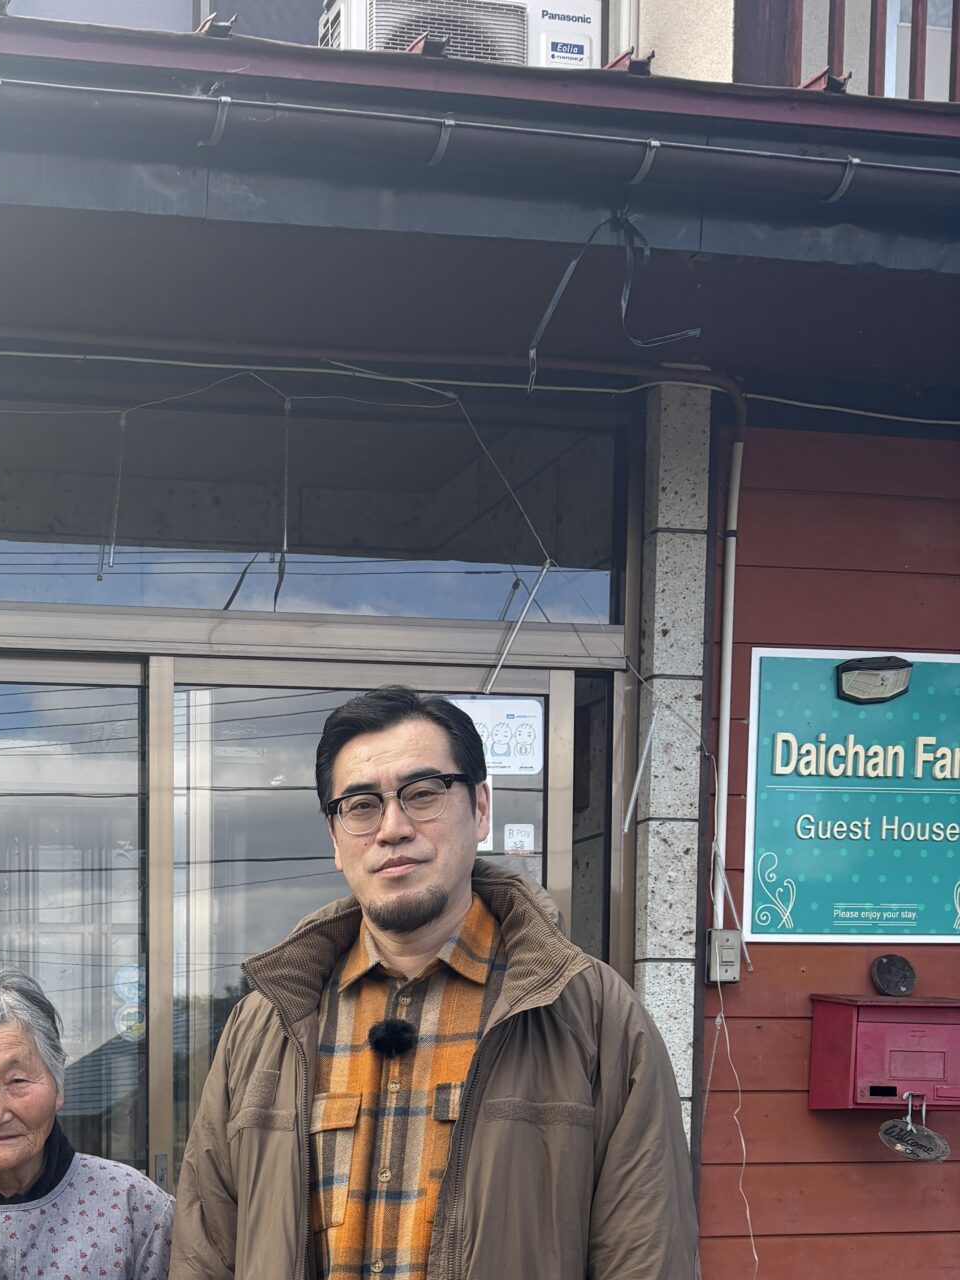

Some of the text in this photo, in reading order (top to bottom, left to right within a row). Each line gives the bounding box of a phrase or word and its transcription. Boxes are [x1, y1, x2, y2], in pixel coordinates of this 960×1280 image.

[541, 10, 592, 24] Panasonic
[557, 43, 579, 54] Eolia
[772, 731, 905, 778] Daichan
[796, 813, 960, 842] Guest House
[833, 909, 919, 921] Please enjoy your stay.
